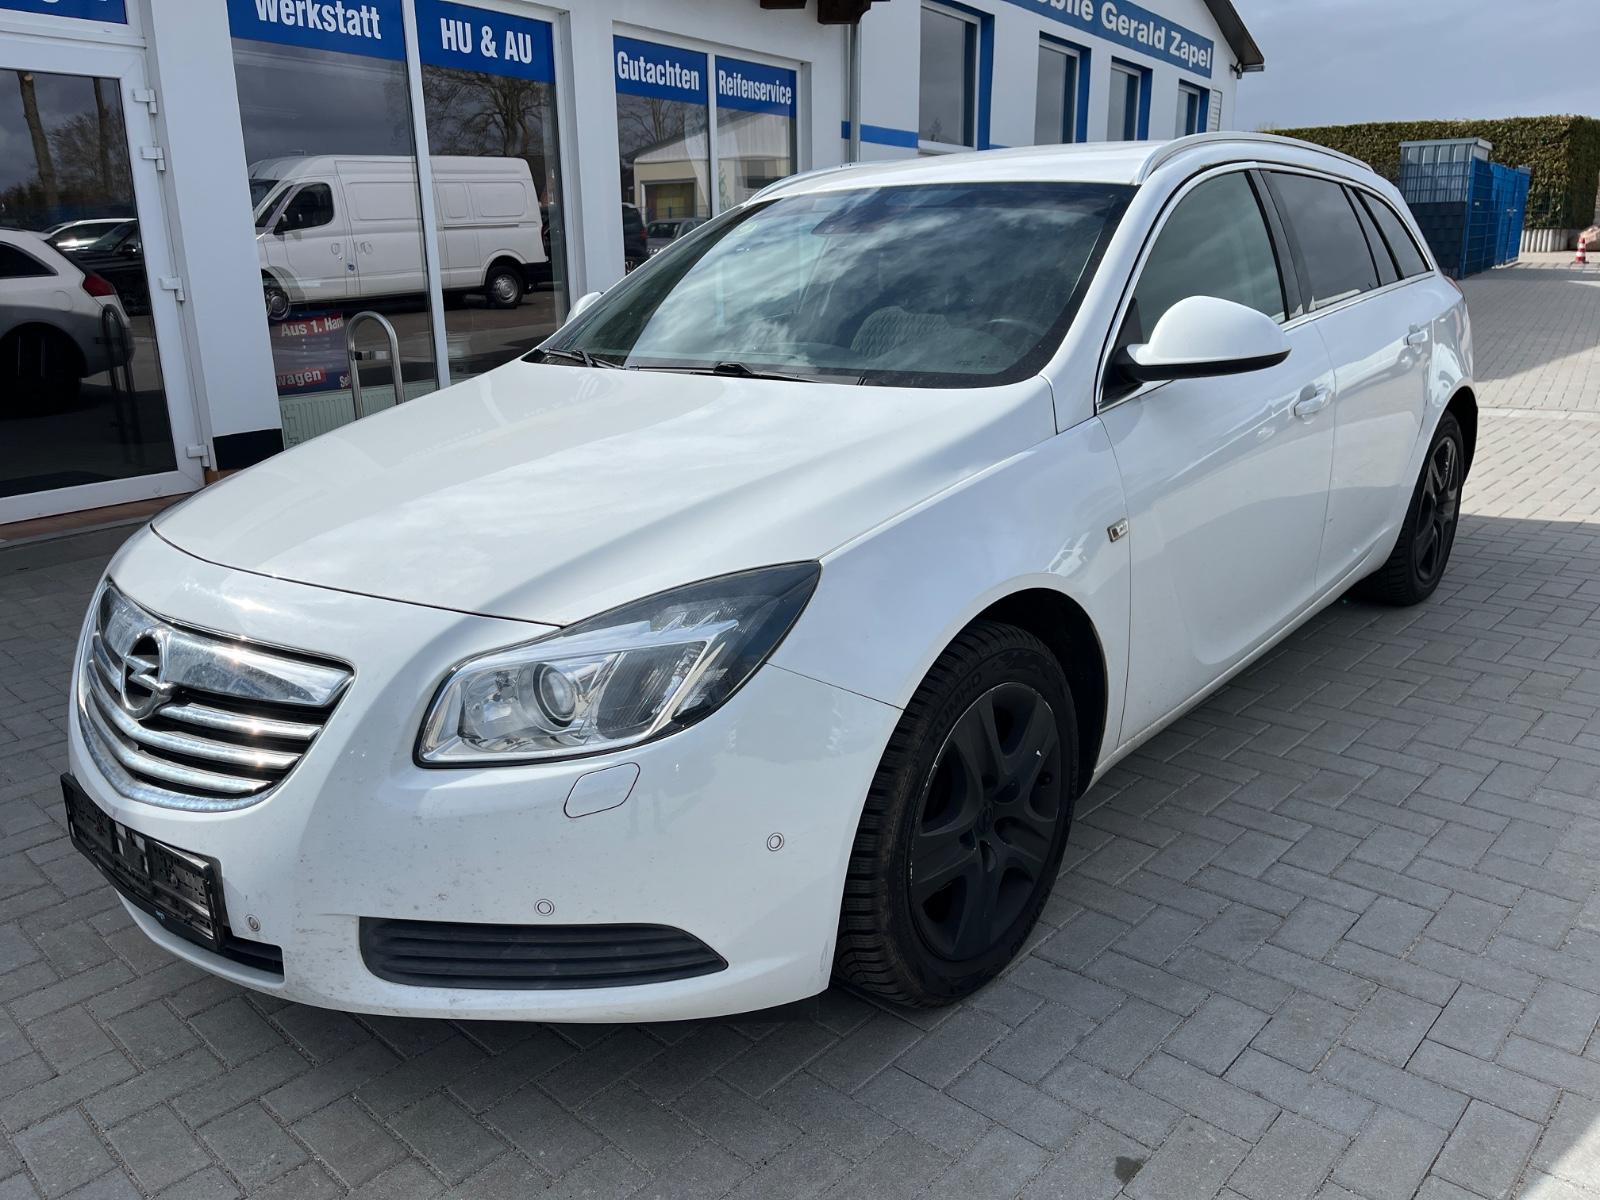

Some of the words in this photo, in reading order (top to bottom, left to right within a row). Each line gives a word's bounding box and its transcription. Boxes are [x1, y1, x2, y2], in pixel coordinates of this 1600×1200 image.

[255, 0, 382, 39] Werkstatt
[1101, 1, 1166, 50] Gerald
[1169, 31, 1212, 69] Zapel
[440, 17, 472, 54] HU
[480, 25, 498, 58] &
[504, 30, 532, 64] AU
[617, 51, 700, 91] Gutachten
[718, 69, 792, 105] Reifenservice
[281, 321, 307, 337] Aus
[310, 319, 322, 333] 1.
